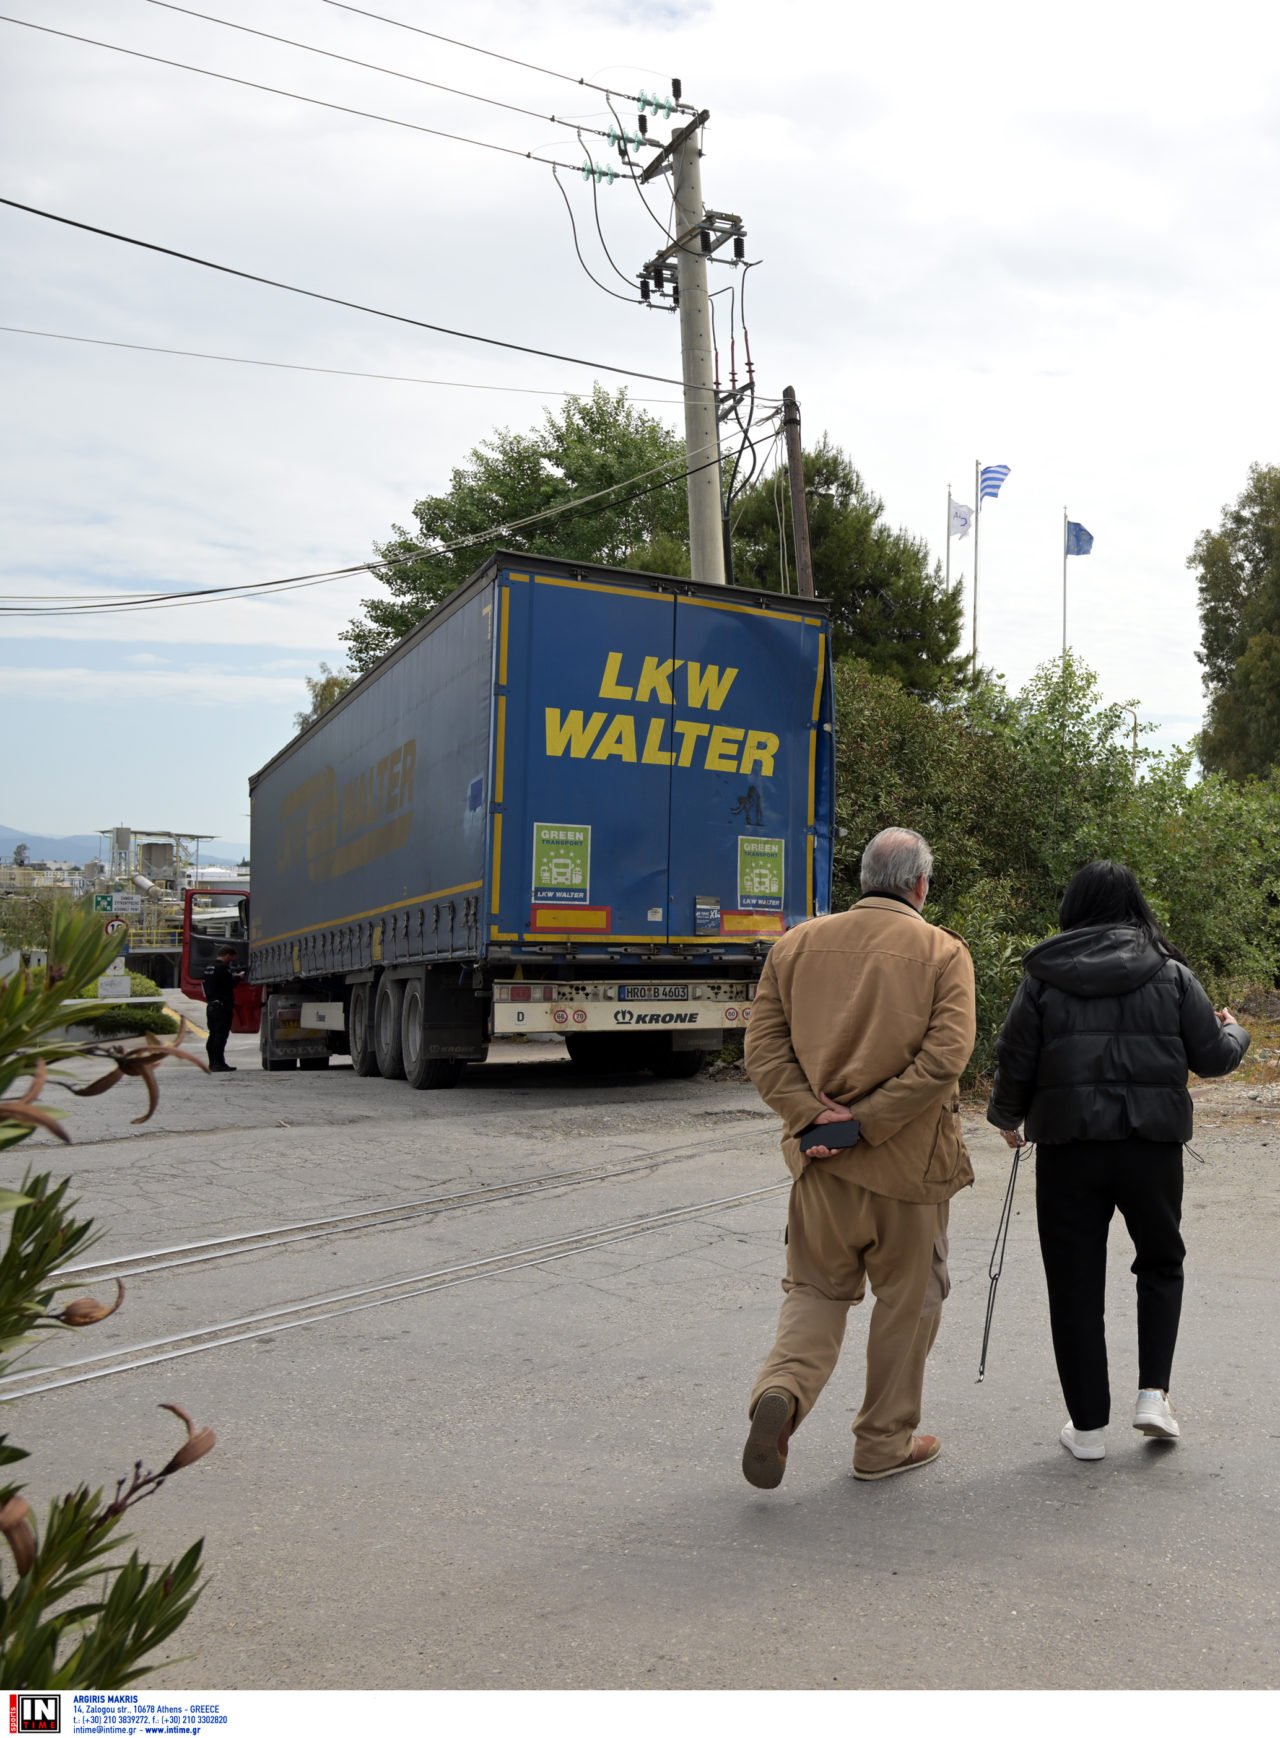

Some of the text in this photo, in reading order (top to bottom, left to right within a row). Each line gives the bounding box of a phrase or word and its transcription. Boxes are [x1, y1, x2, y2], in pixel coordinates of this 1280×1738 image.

[599, 652, 738, 711] LKW
[545, 707, 780, 777] WALTER
[541, 830, 583, 841] GREEN
[744, 843, 778, 853] GREEN
[626, 986, 686, 998] HRO B 4603
[517, 1011, 525, 1022] D
[635, 1013, 699, 1025] KRONE
